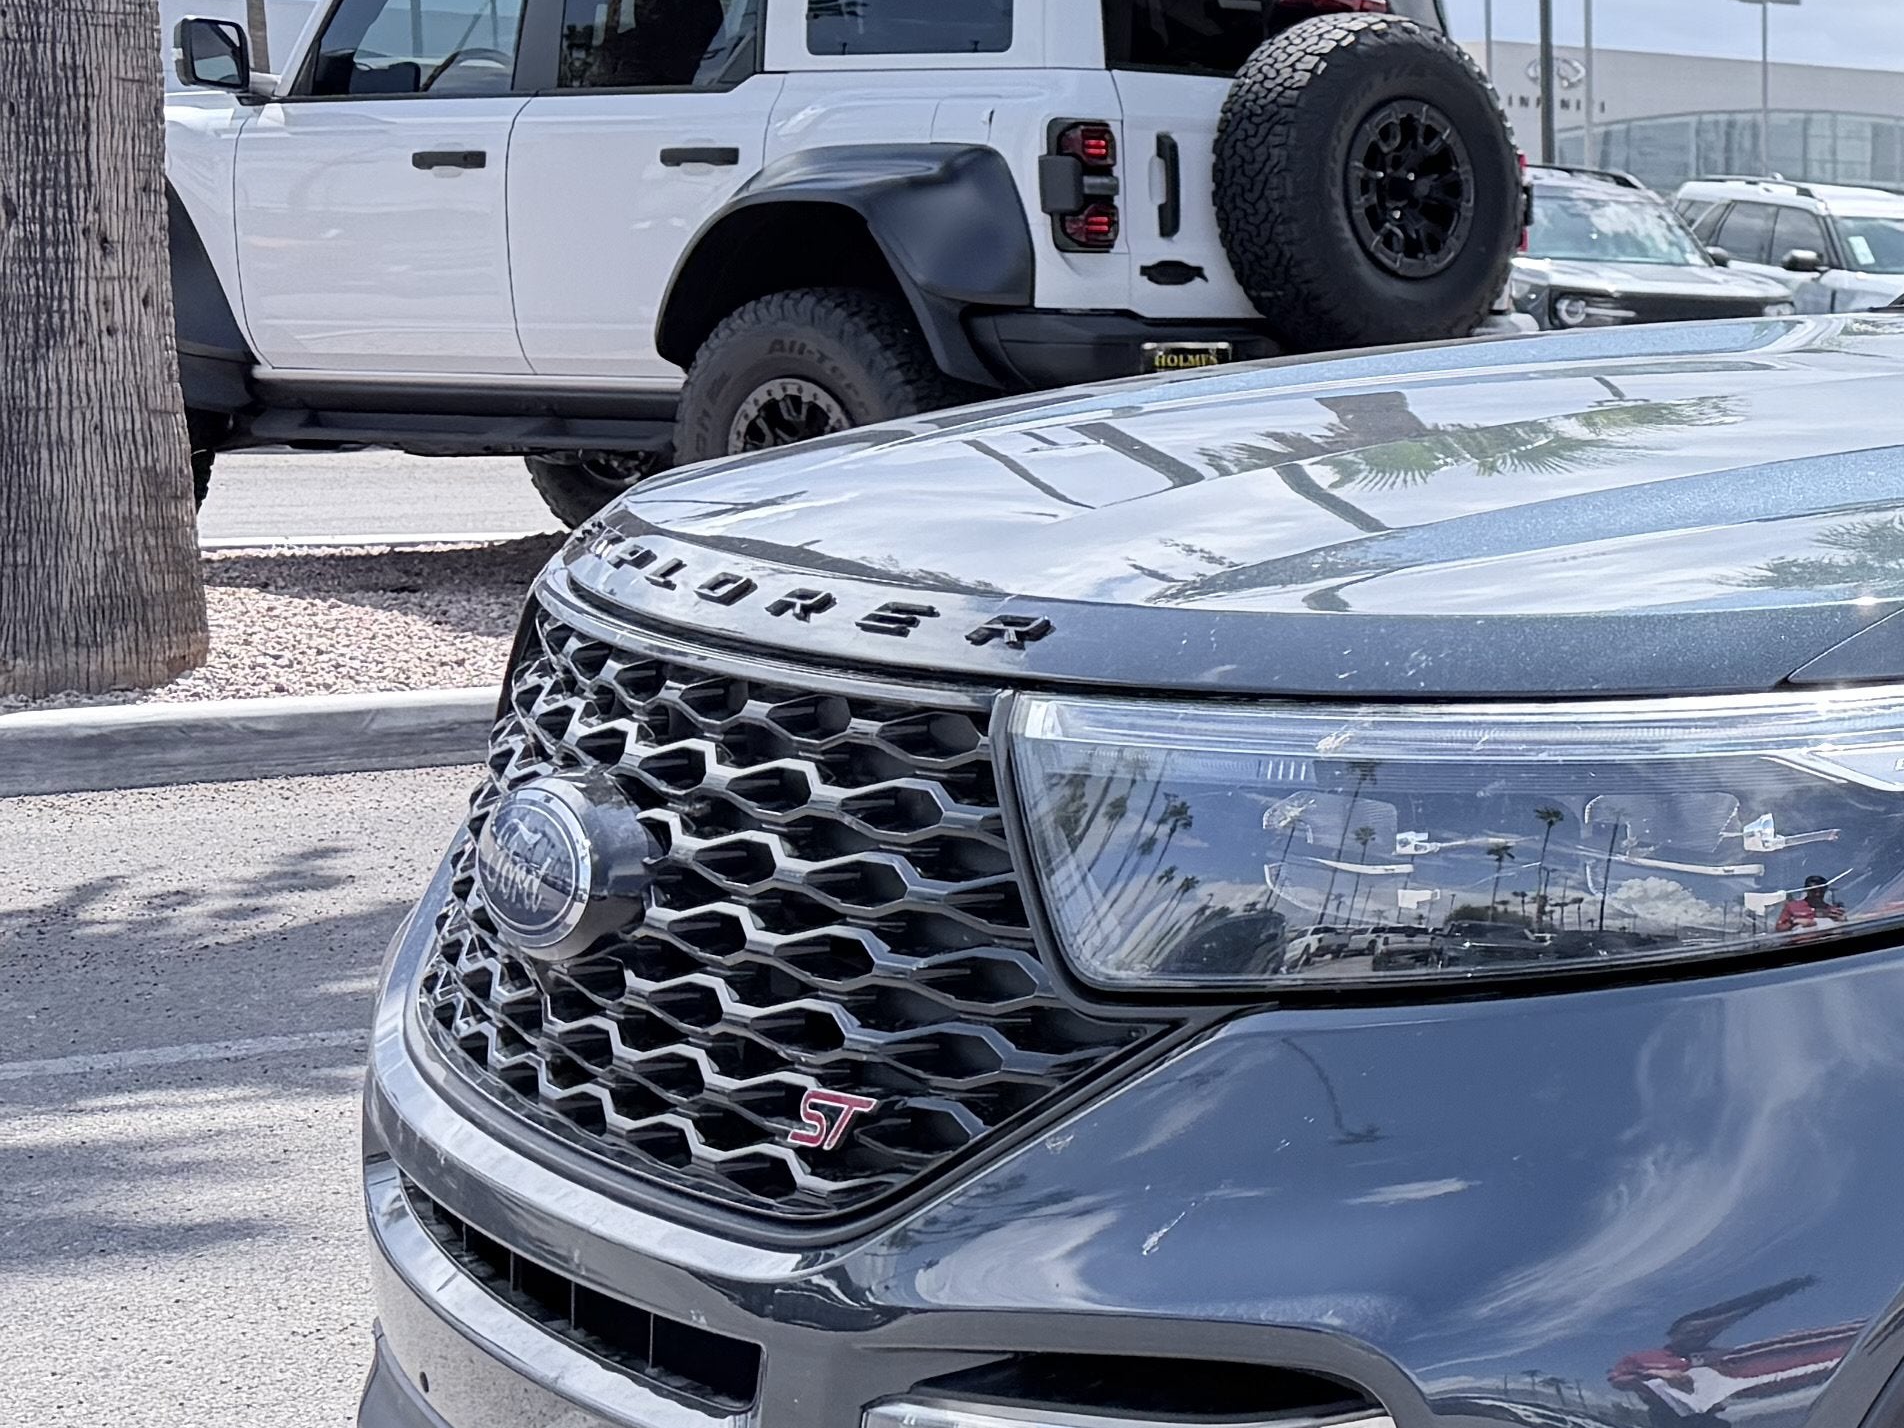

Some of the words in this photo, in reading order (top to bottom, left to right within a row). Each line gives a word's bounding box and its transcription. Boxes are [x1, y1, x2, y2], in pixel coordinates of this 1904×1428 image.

[1507, 95, 1605, 113] INNII
[575, 522, 1056, 650] PLORER
[486, 818, 552, 913] Ford
[786, 1088, 878, 1151] ST
